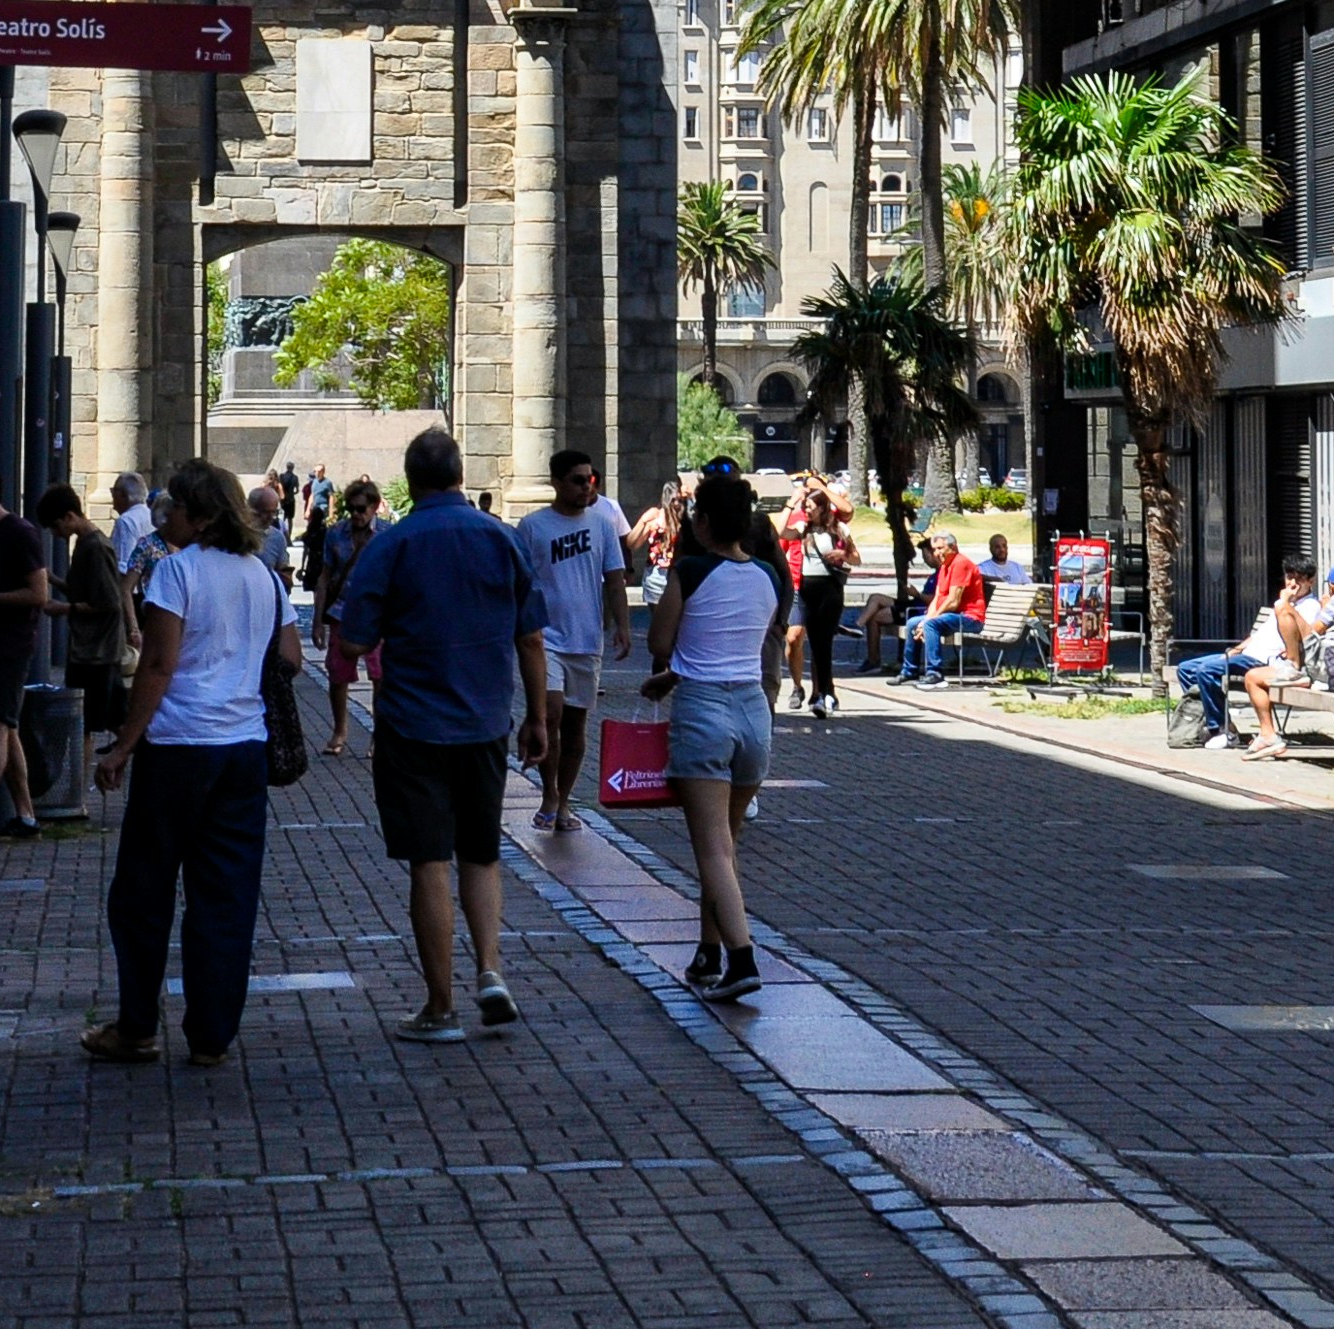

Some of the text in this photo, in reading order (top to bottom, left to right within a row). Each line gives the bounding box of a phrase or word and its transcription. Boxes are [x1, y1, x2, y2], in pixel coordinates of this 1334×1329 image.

[56, 17, 106, 39] Solís
[204, 49, 231, 61] 2 min
[550, 528, 592, 565] NIKE
